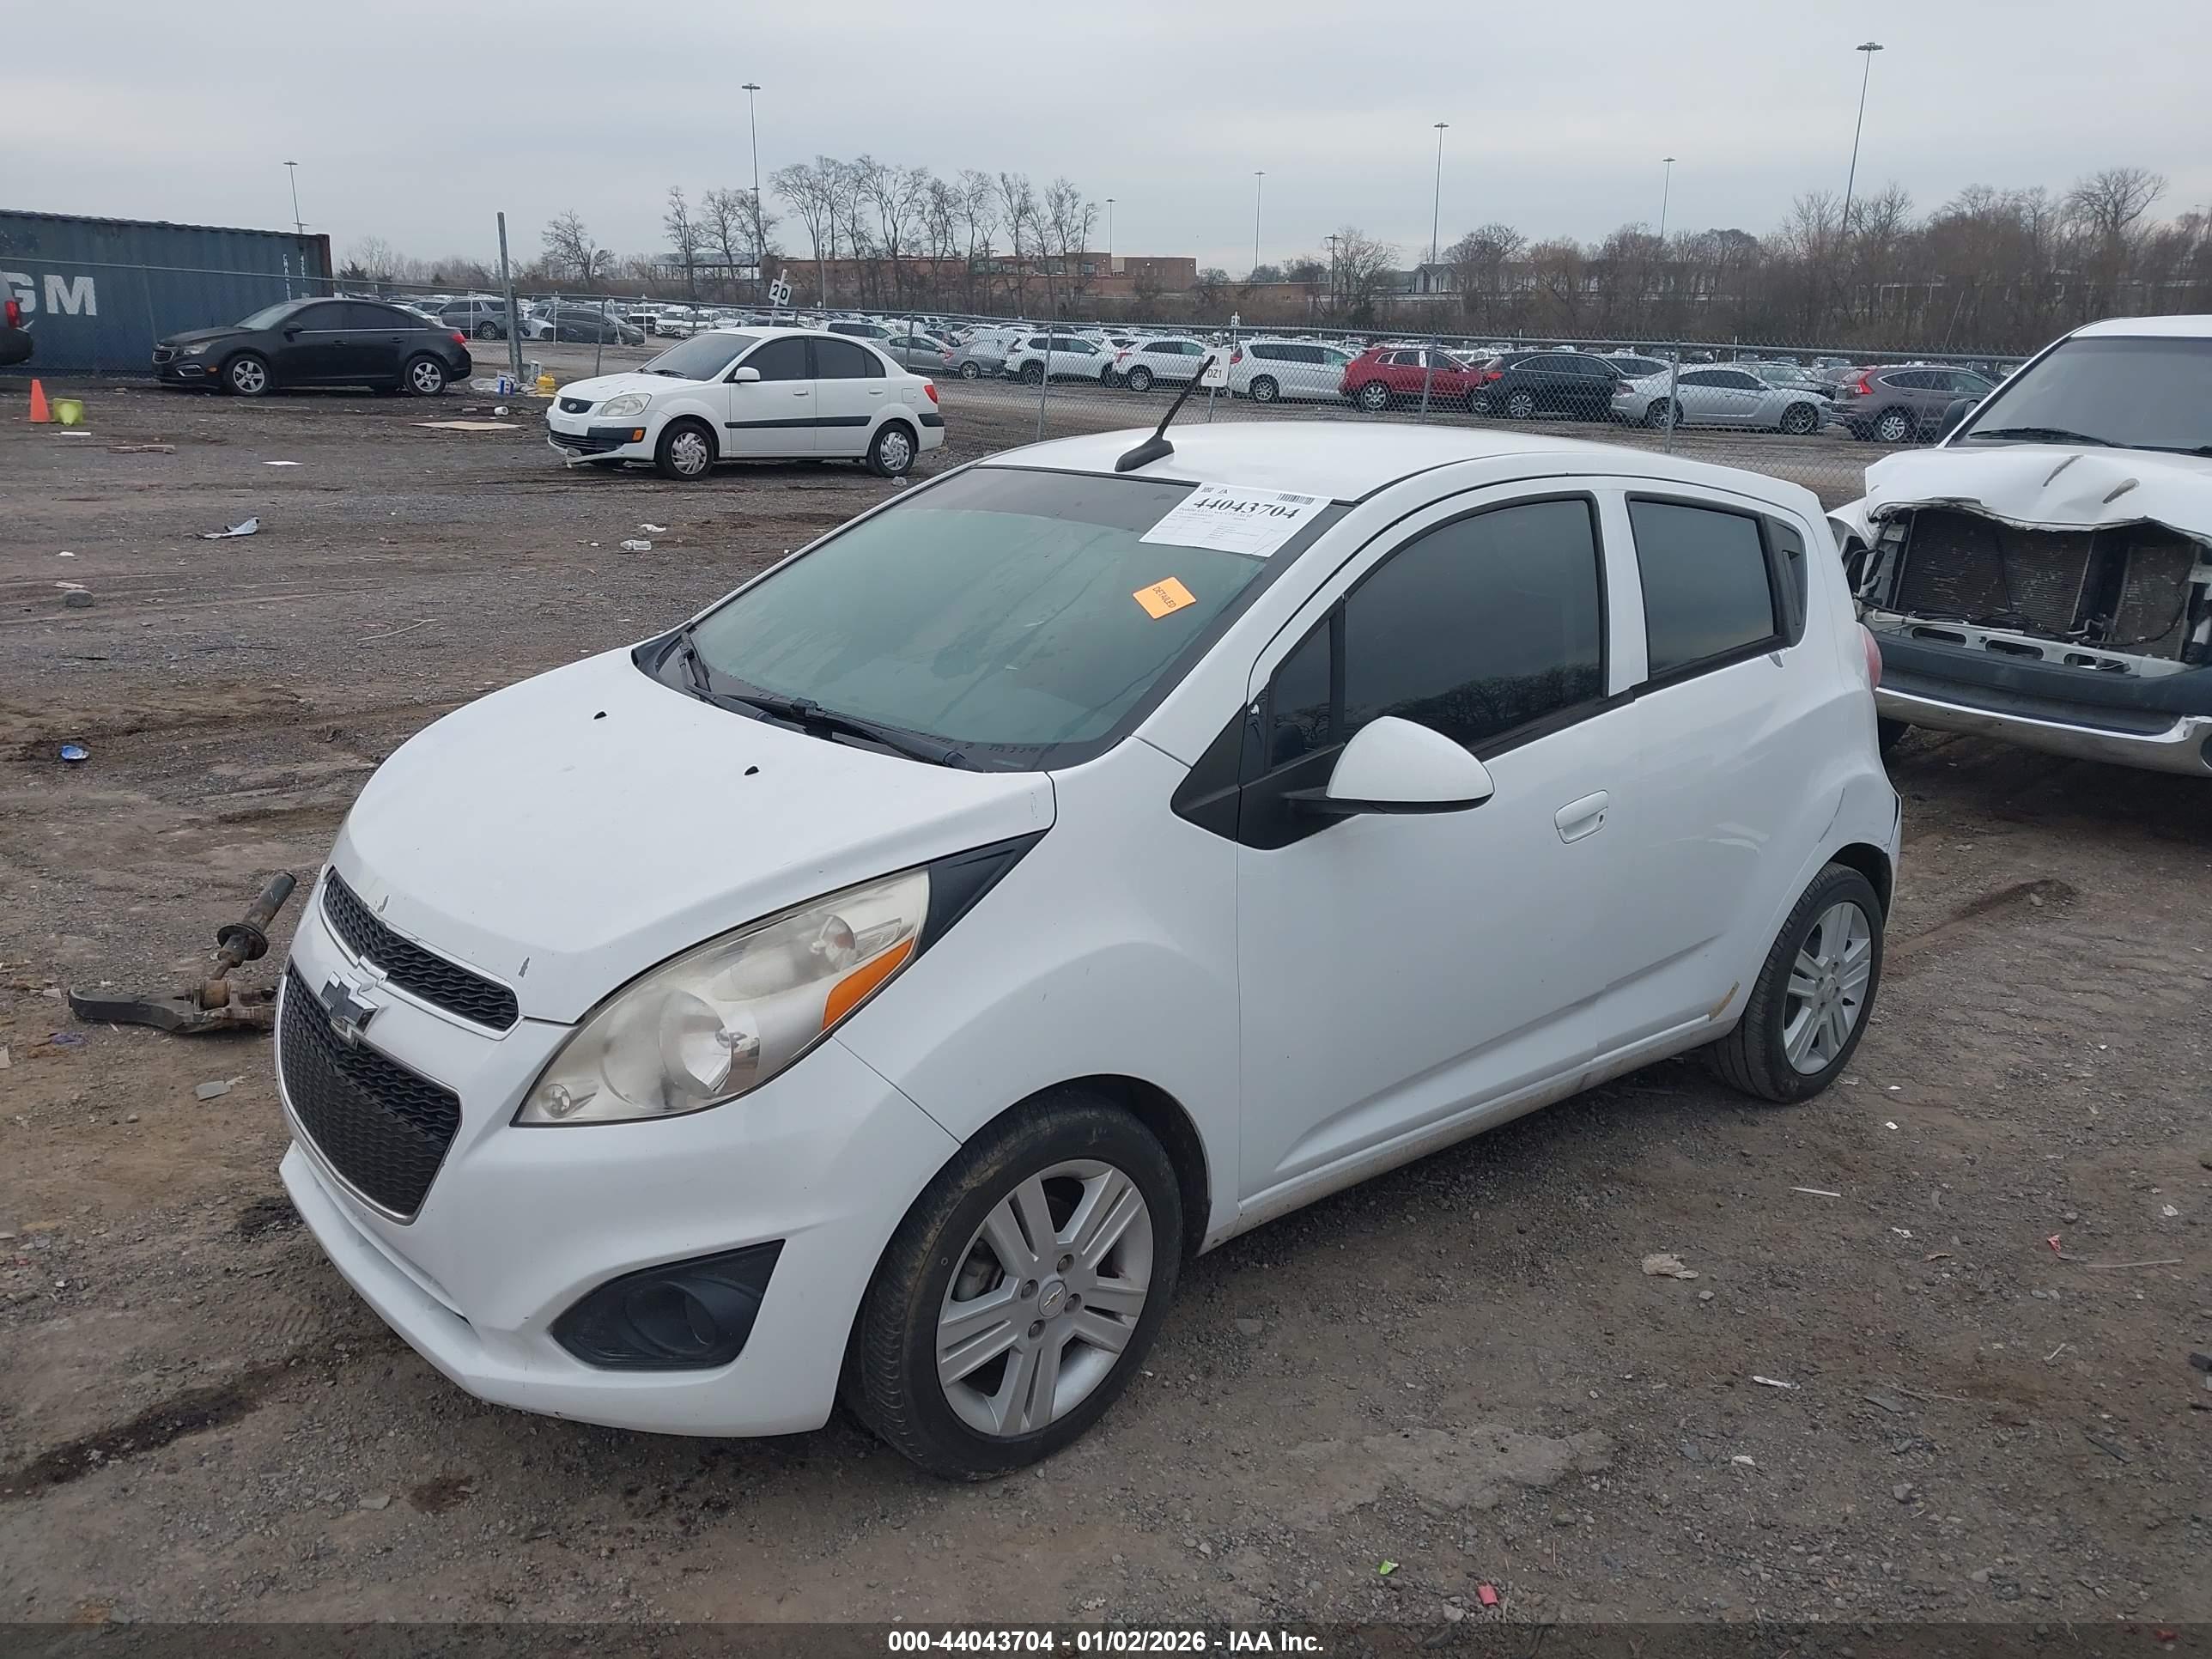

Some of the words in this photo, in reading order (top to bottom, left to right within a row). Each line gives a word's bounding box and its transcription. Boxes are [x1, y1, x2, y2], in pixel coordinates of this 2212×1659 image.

[771, 283, 788, 300] 20
[1206, 368, 1222, 379] DZ1
[1194, 497, 1301, 520] 44043704
